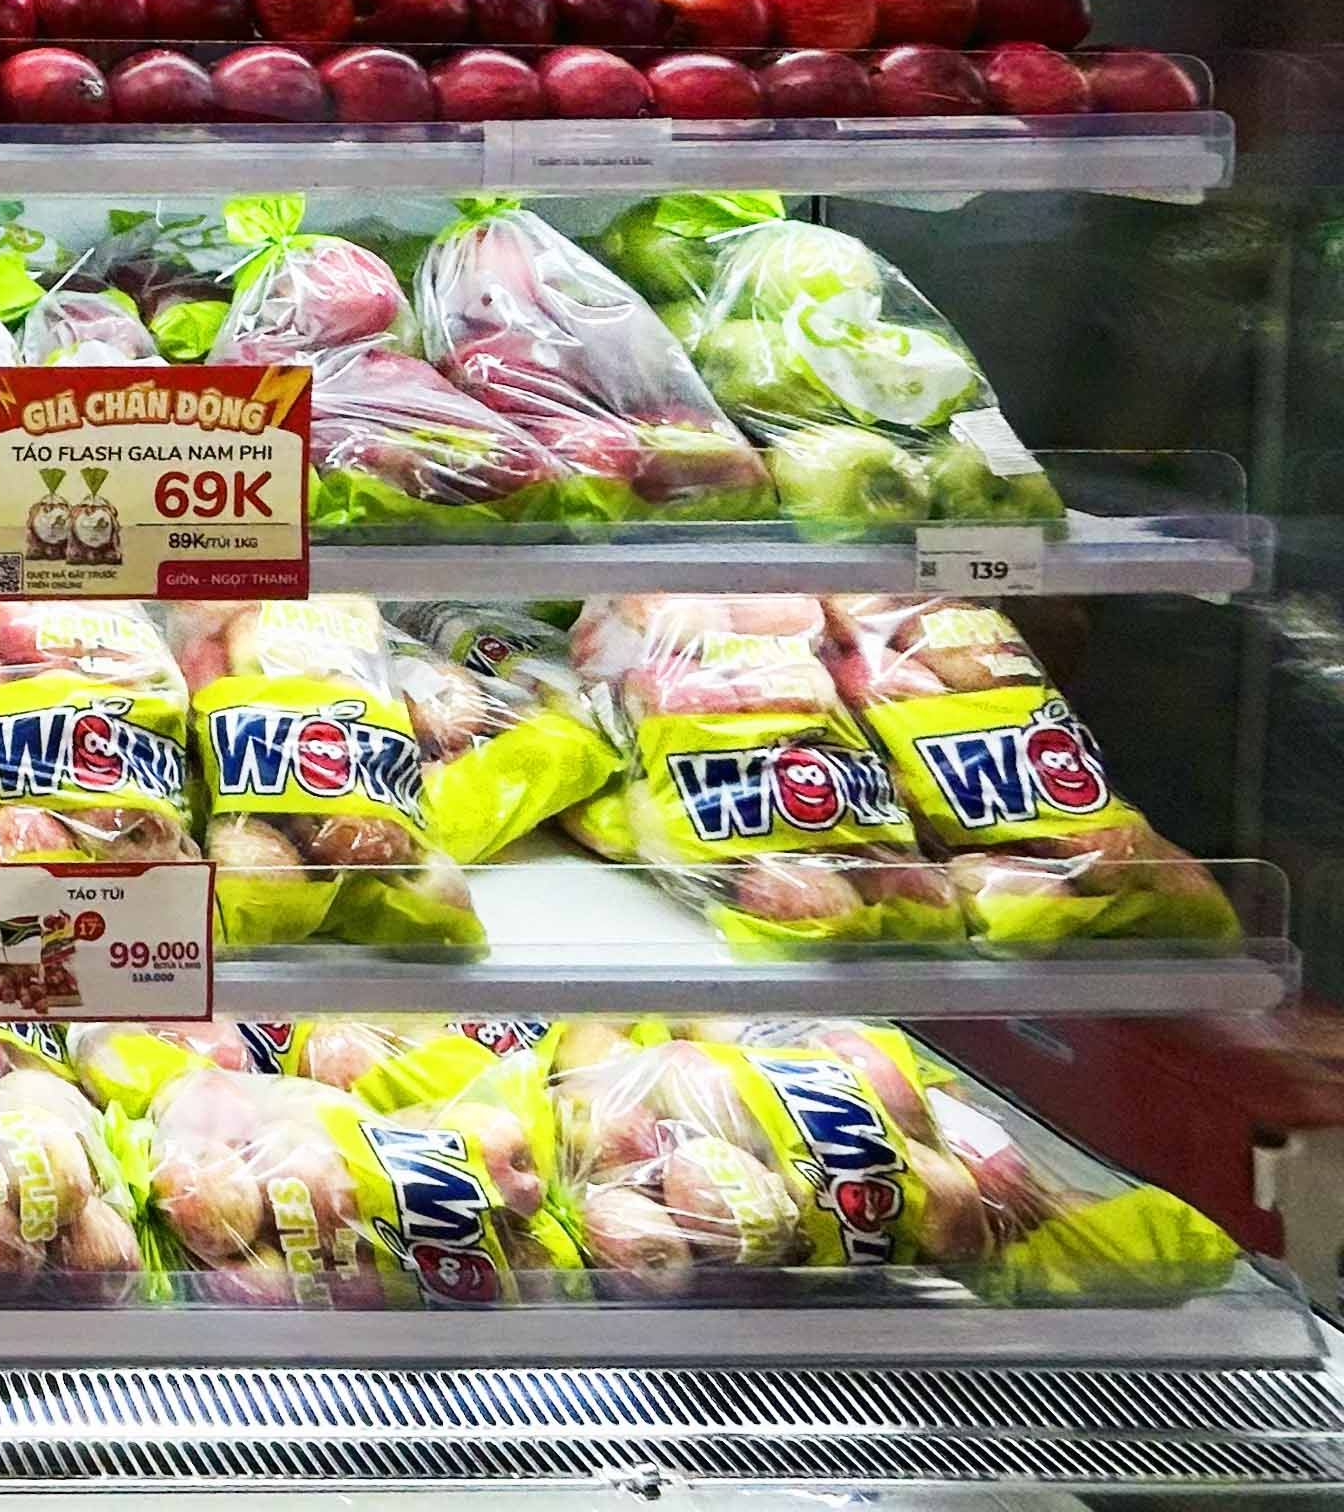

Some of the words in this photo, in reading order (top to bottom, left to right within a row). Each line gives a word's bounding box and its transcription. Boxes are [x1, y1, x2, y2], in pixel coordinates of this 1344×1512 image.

[22, 387, 81, 434] GIÁ
[85, 378, 169, 426] CHẤN
[176, 386, 270, 434] ĐỘNG
[12, 442, 53, 462] TÁO
[58, 445, 122, 462] FLASH
[128, 445, 183, 462] GALA
[188, 445, 233, 461] NAM
[239, 444, 273, 460] PHI
[153, 469, 273, 519] 69K
[234, 538, 259, 549] 1KG
[166, 570, 200, 586] GIÒN
[210, 571, 250, 587] NGỌT
[252, 572, 298, 586] THANH
[969, 561, 1009, 580] 139
[912, 721, 1110, 831] WO
[67, 886, 97, 900] TÁO
[102, 886, 125, 900] TÚI
[78, 922, 98, 936] 17
[110, 941, 200, 969] 99.000
